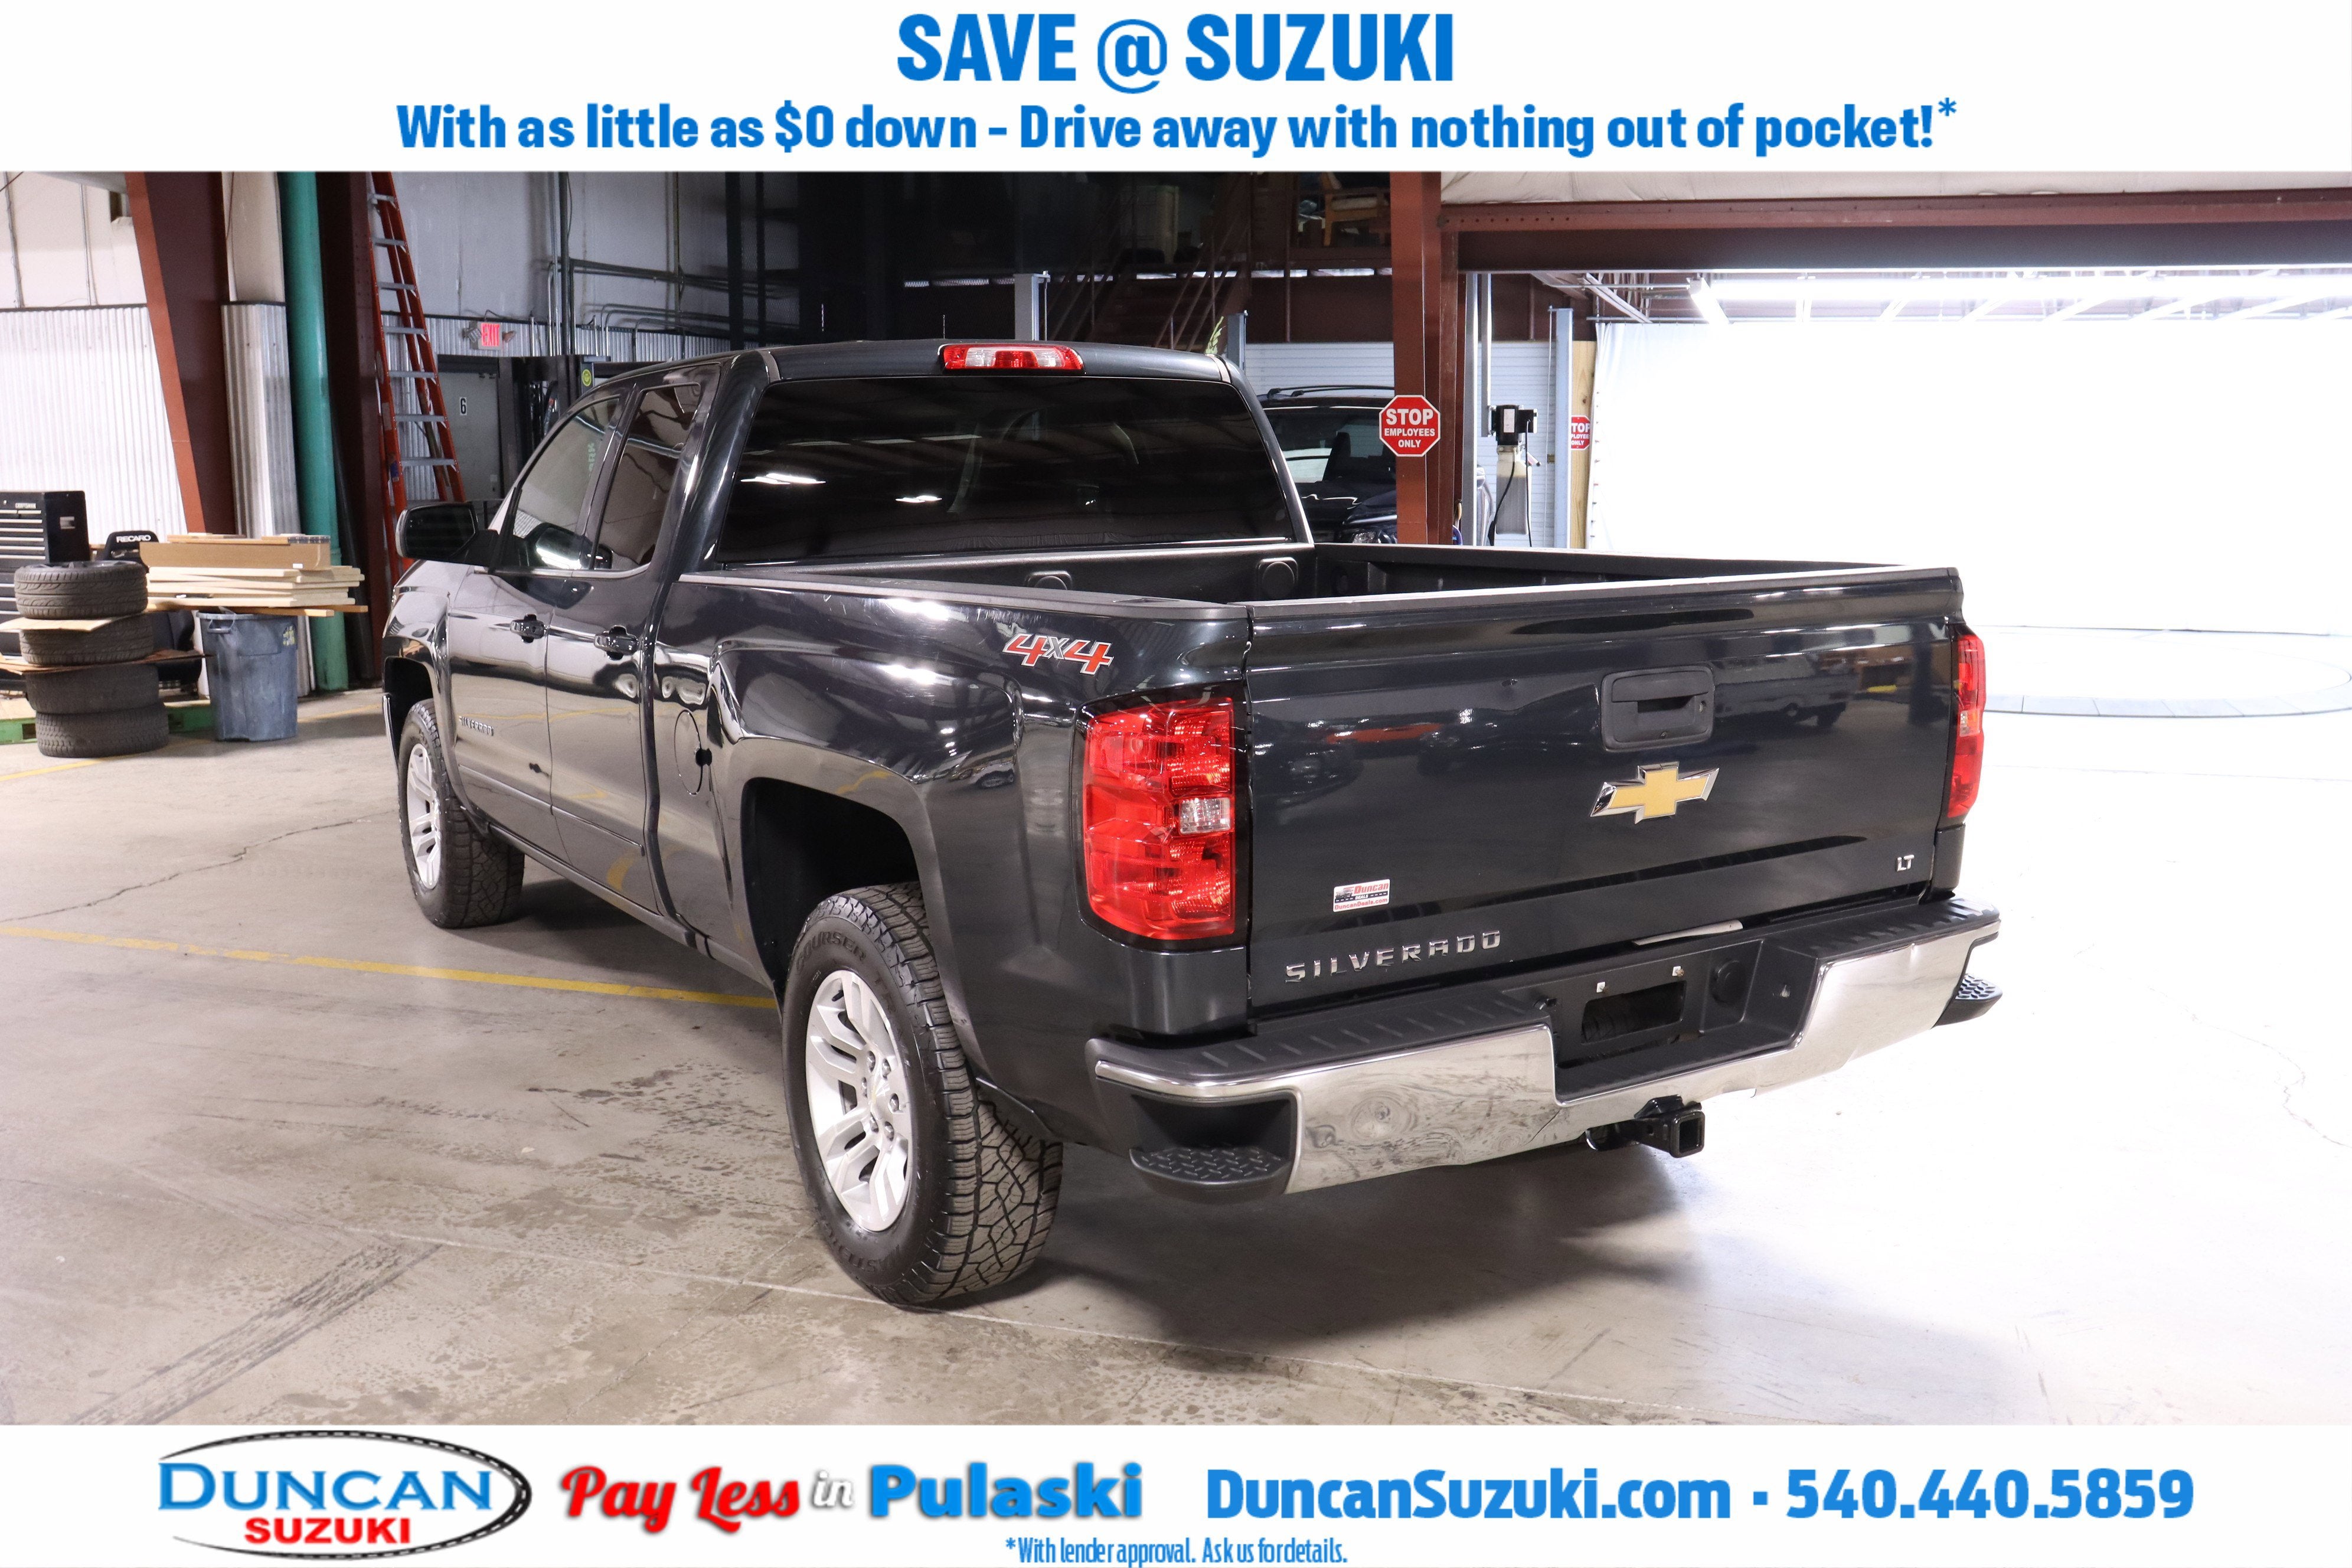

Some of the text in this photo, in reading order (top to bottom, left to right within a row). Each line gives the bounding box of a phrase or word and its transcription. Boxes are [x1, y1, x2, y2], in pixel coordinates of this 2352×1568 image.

[481, 323, 500, 347] EXIT
[460, 398, 466, 414] 6
[1386, 408, 1433, 425] STOP
[1384, 428, 1436, 436] EMPLOYEES
[1571, 423, 1591, 433] TOP
[1398, 439, 1422, 447] ONLY
[116, 534, 151, 543] RECARO
[458, 716, 494, 736] SILVERADO
[1897, 854, 1915, 871] LT
[1354, 883, 1389, 894] Duncan
[1335, 899, 1387, 910] DuncanDeals.com
[1285, 930, 1501, 982] SILVERADO
